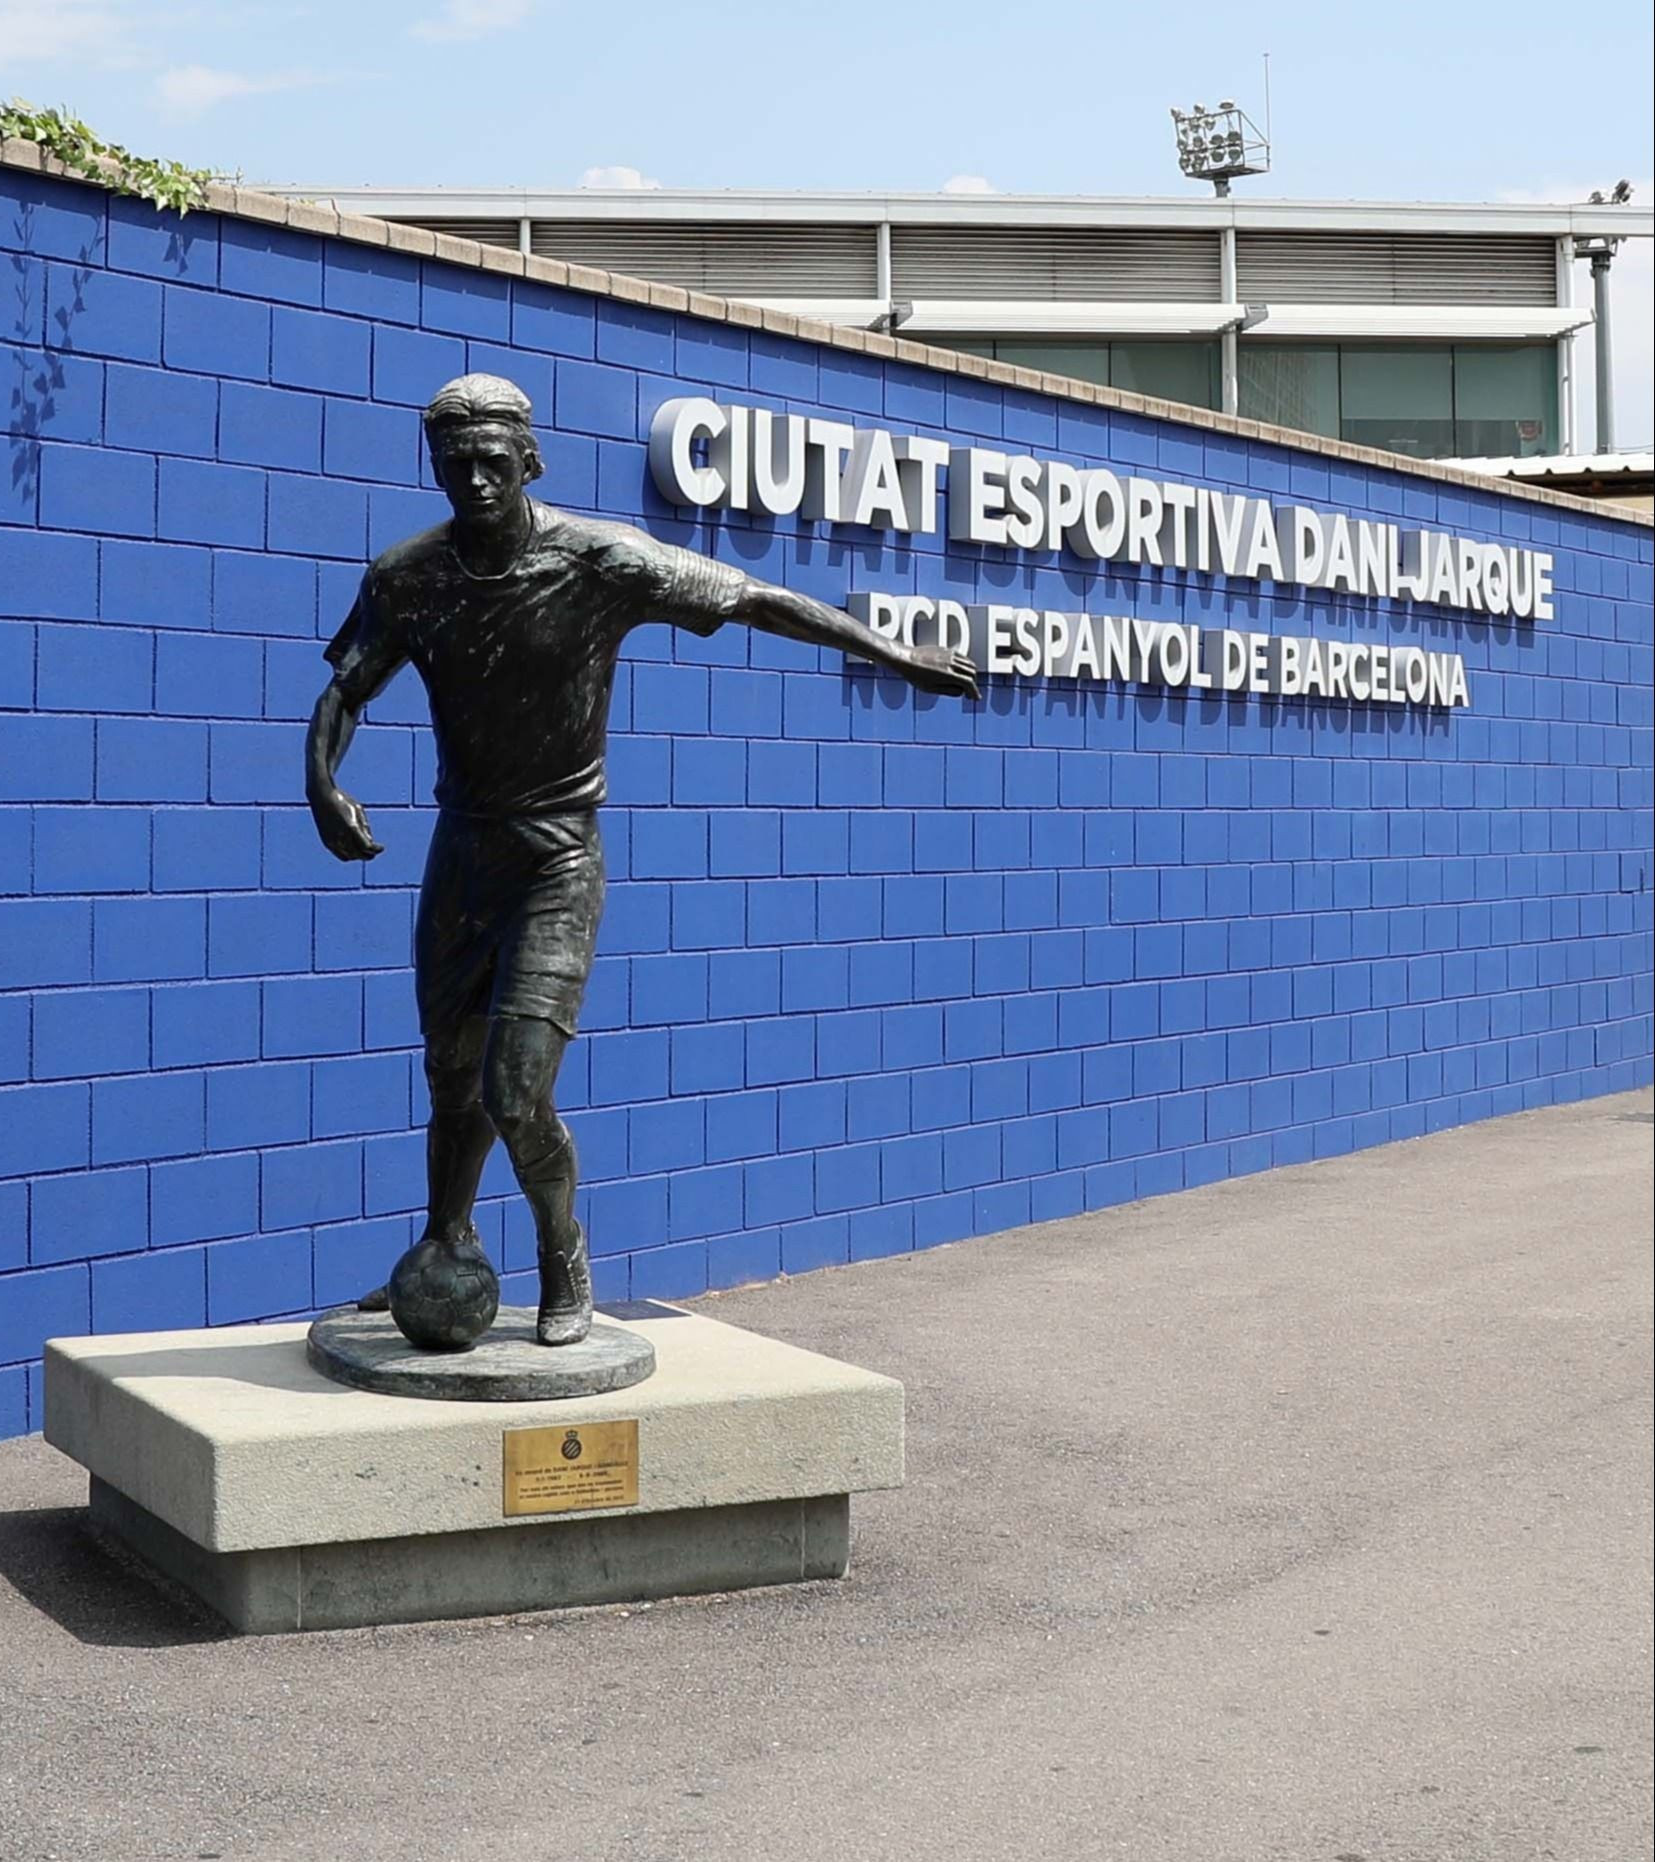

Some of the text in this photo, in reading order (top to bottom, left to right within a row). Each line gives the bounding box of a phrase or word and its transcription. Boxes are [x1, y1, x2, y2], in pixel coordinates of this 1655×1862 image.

[669, 397, 1555, 621] CIUTAT ESPORTIVA DANI JARQUE
[986, 604, 1213, 688] ESPANYOL
[1222, 629, 1270, 693] DE
[1279, 636, 1470, 708] BARCELONA
